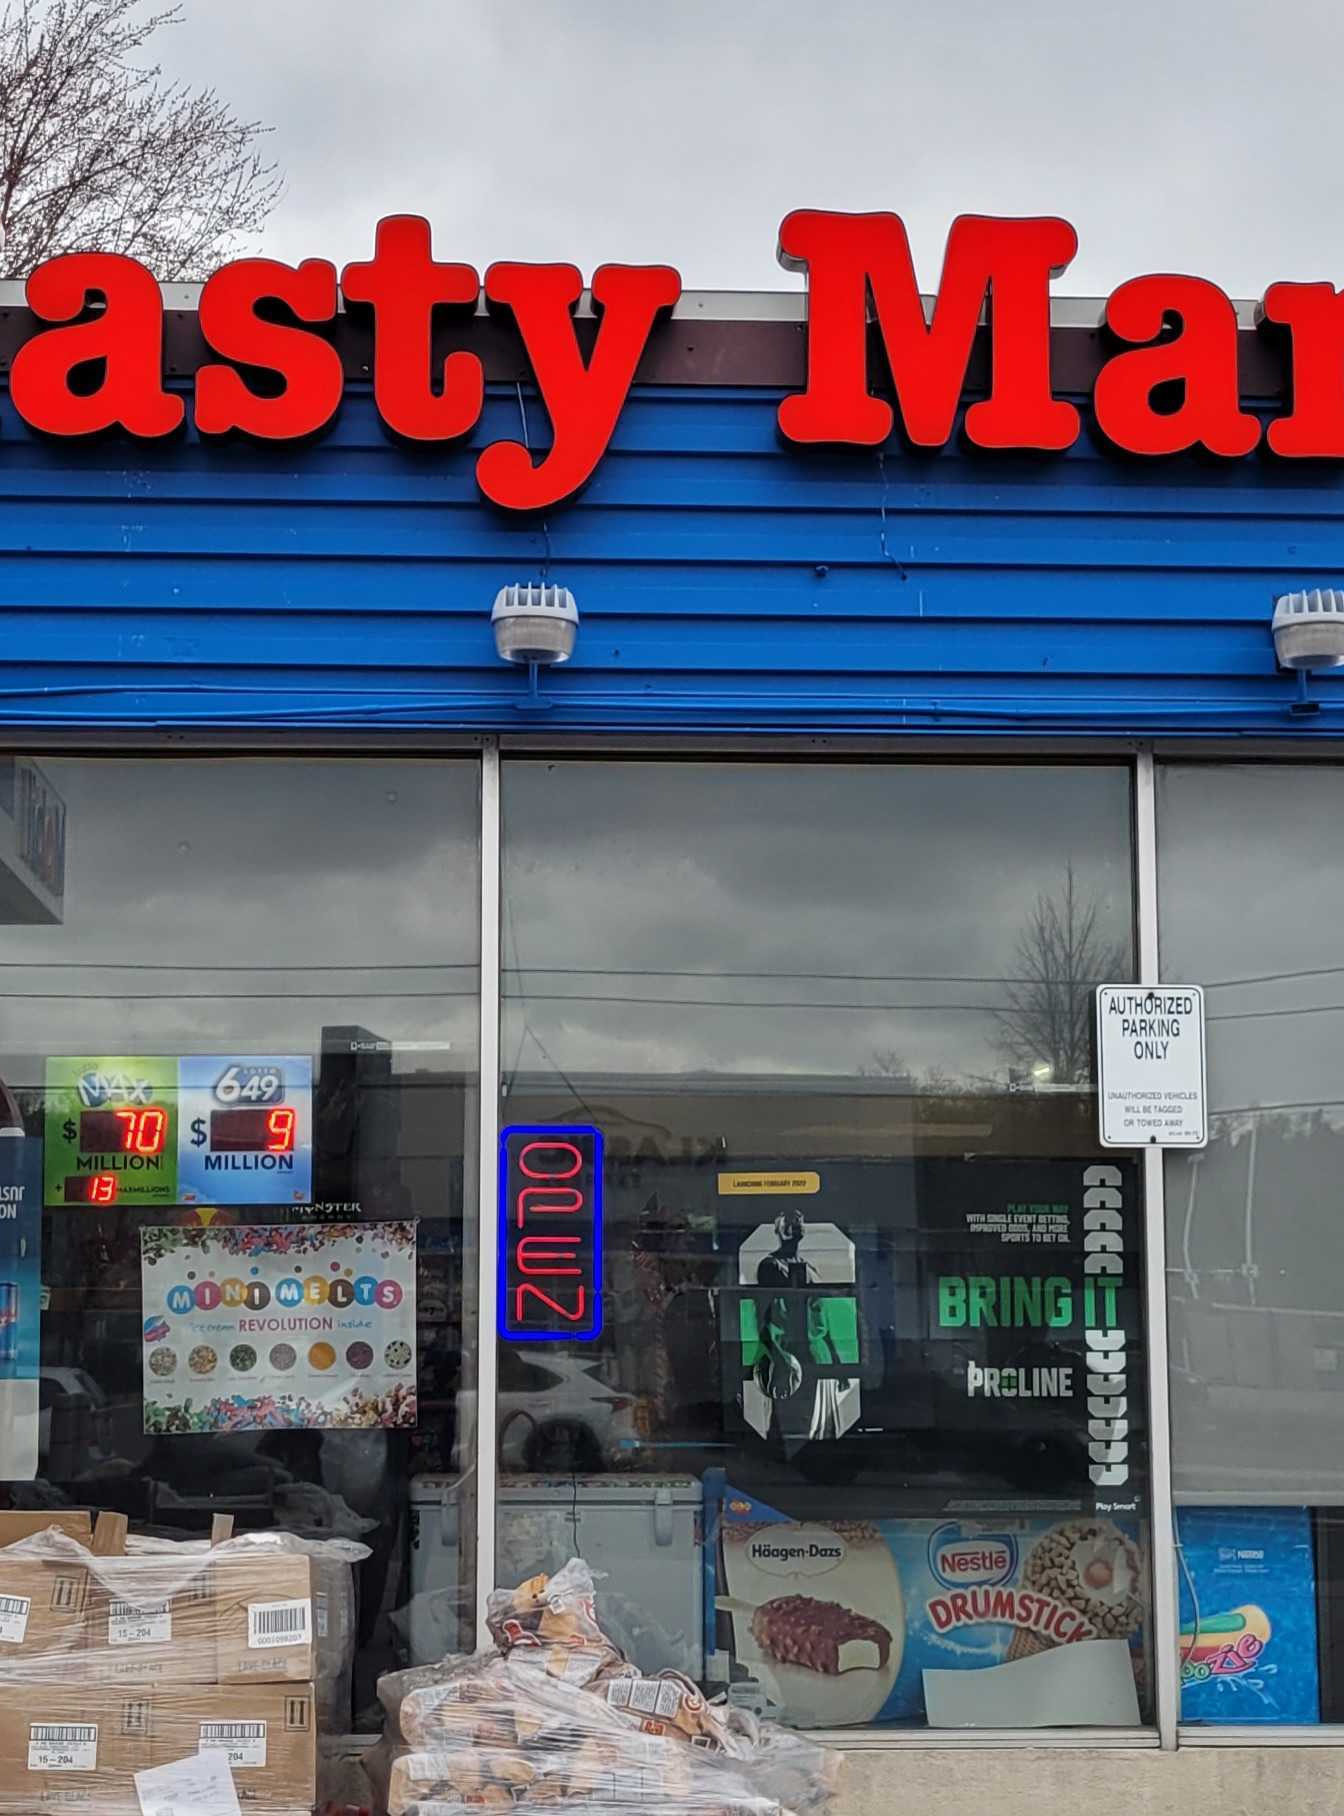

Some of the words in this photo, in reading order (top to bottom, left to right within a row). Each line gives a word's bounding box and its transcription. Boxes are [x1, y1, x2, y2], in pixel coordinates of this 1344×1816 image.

[1109, 997, 1193, 1015] AUTHORIZED
[1122, 1019, 1180, 1037] PARKING
[1134, 1041, 1169, 1059] ONLY
[1108, 1092, 1162, 1100] UNAUTHORIZED
[1164, 1092, 1198, 1100] VEHICLES
[1154, 1105, 1183, 1113] TAGGED
[116, 1110, 164, 1153] 70
[268, 1110, 294, 1151] 9
[1124, 1119, 1134, 1127] OR
[1137, 1119, 1163, 1127] TOWED
[1165, 1119, 1183, 1127] AWAY
[76, 1156, 158, 1171] MILLION
[205, 1155, 294, 1171] MILLION
[91, 1176, 114, 1201] 13
[966, 1214, 985, 1223] WITH
[1014, 1214, 1036, 1223] EVENT
[516, 1142, 585, 1321] OPEN
[1032, 1224, 1047, 1232] AND
[1049, 1224, 1067, 1232] MORE
[1001, 1233, 1030, 1242] SPORTS
[1032, 1233, 1041, 1242] TO
[1043, 1233, 1056, 1242] BET
[170, 1282, 265, 1312] MINI
[277, 1279, 399, 1306] MELTS
[939, 1276, 1072, 1328] BRING
[1084, 1276, 1123, 1328] IT
[239, 1317, 333, 1332] REVOLUTION
[337, 1319, 373, 1329] inside
[967, 1360, 1073, 1397] PROLINE
[1096, 1502, 1112, 1512] Play
[1113, 1502, 1137, 1511] Smart
[752, 1543, 842, 1561] Häagen-Dazs
[928, 1589, 1095, 1643] DRUMSTICK
